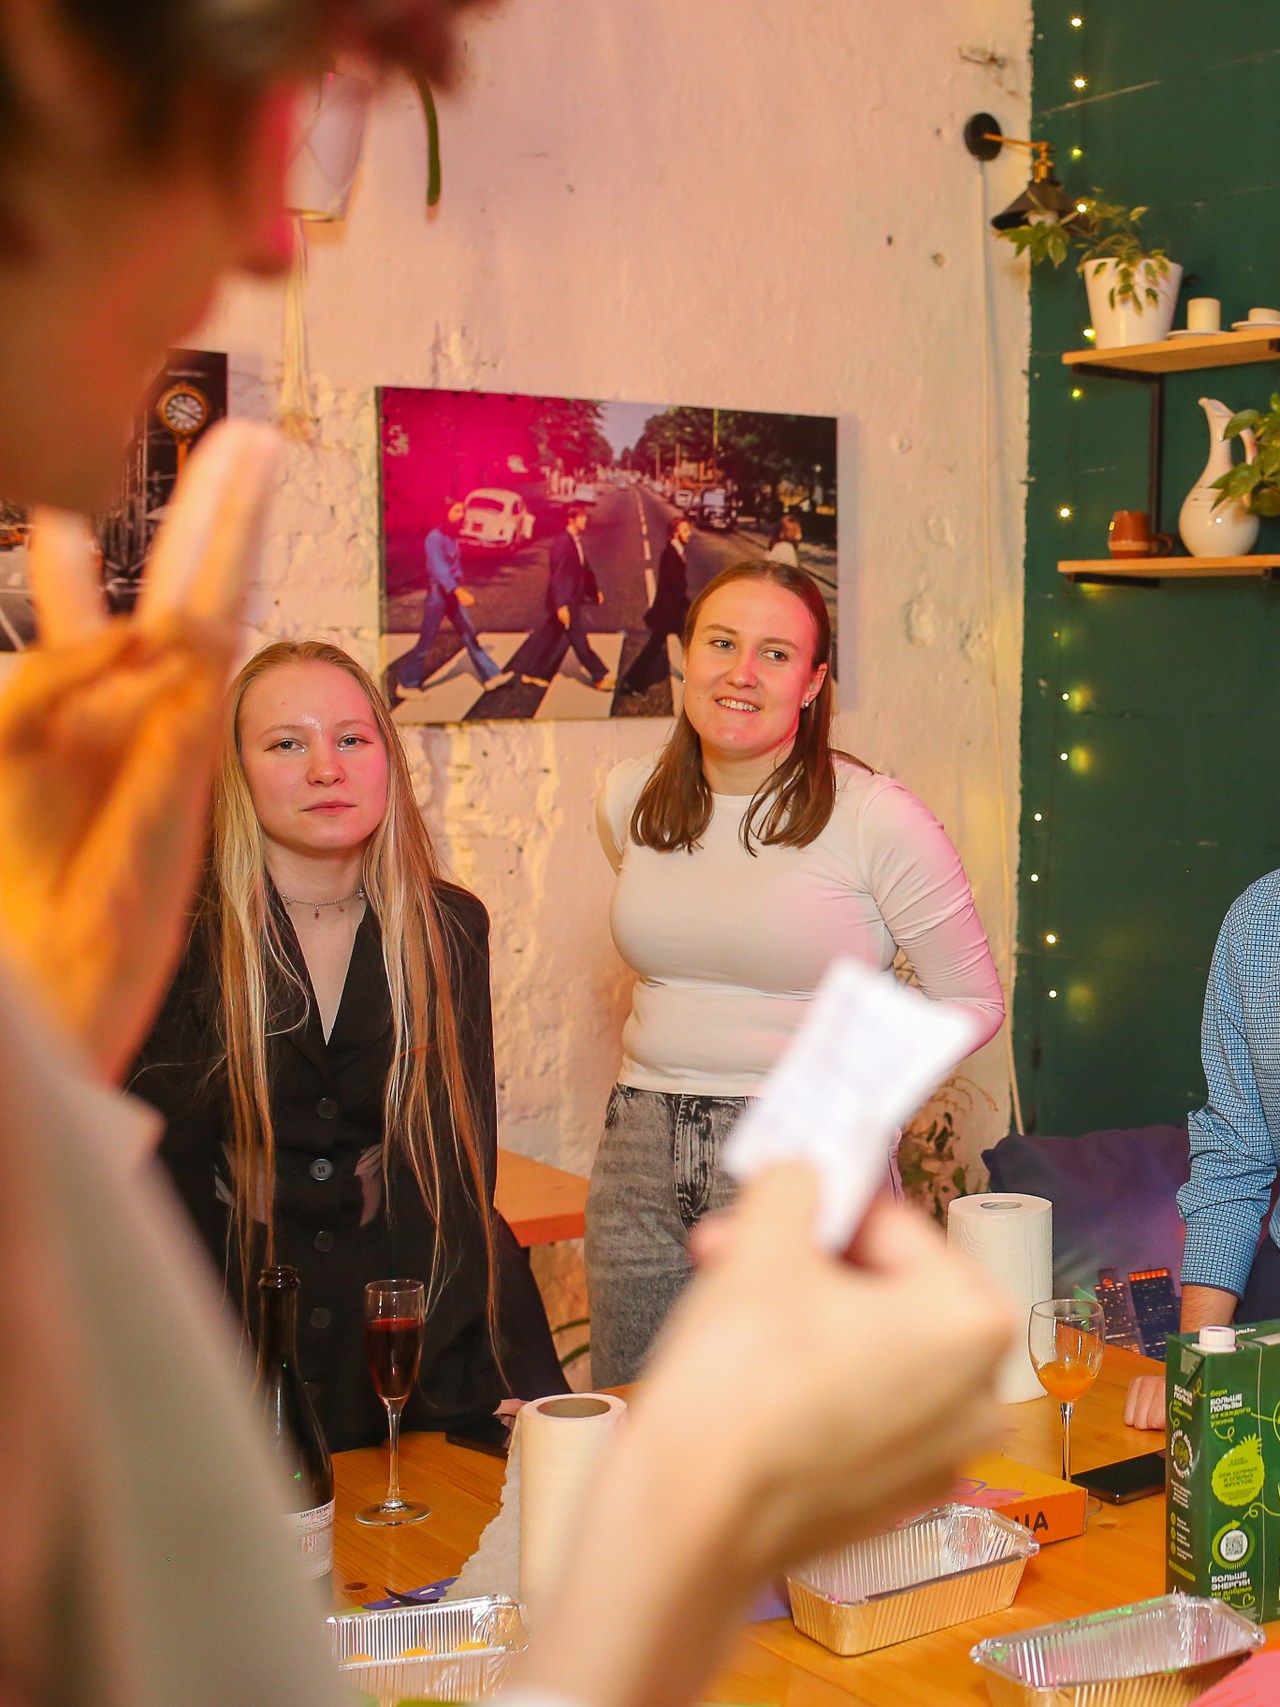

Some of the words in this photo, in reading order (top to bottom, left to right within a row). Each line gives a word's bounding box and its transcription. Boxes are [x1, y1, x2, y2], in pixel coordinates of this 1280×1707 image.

[1210, 1393, 1243, 1406] БОЛЬШЕ
[1210, 1400, 1243, 1413] ПОЛЬЗЫ
[1211, 1571, 1248, 1583] БОЛЬШЕ
[1211, 1578, 1251, 1591] ЭНЕРГИИ
